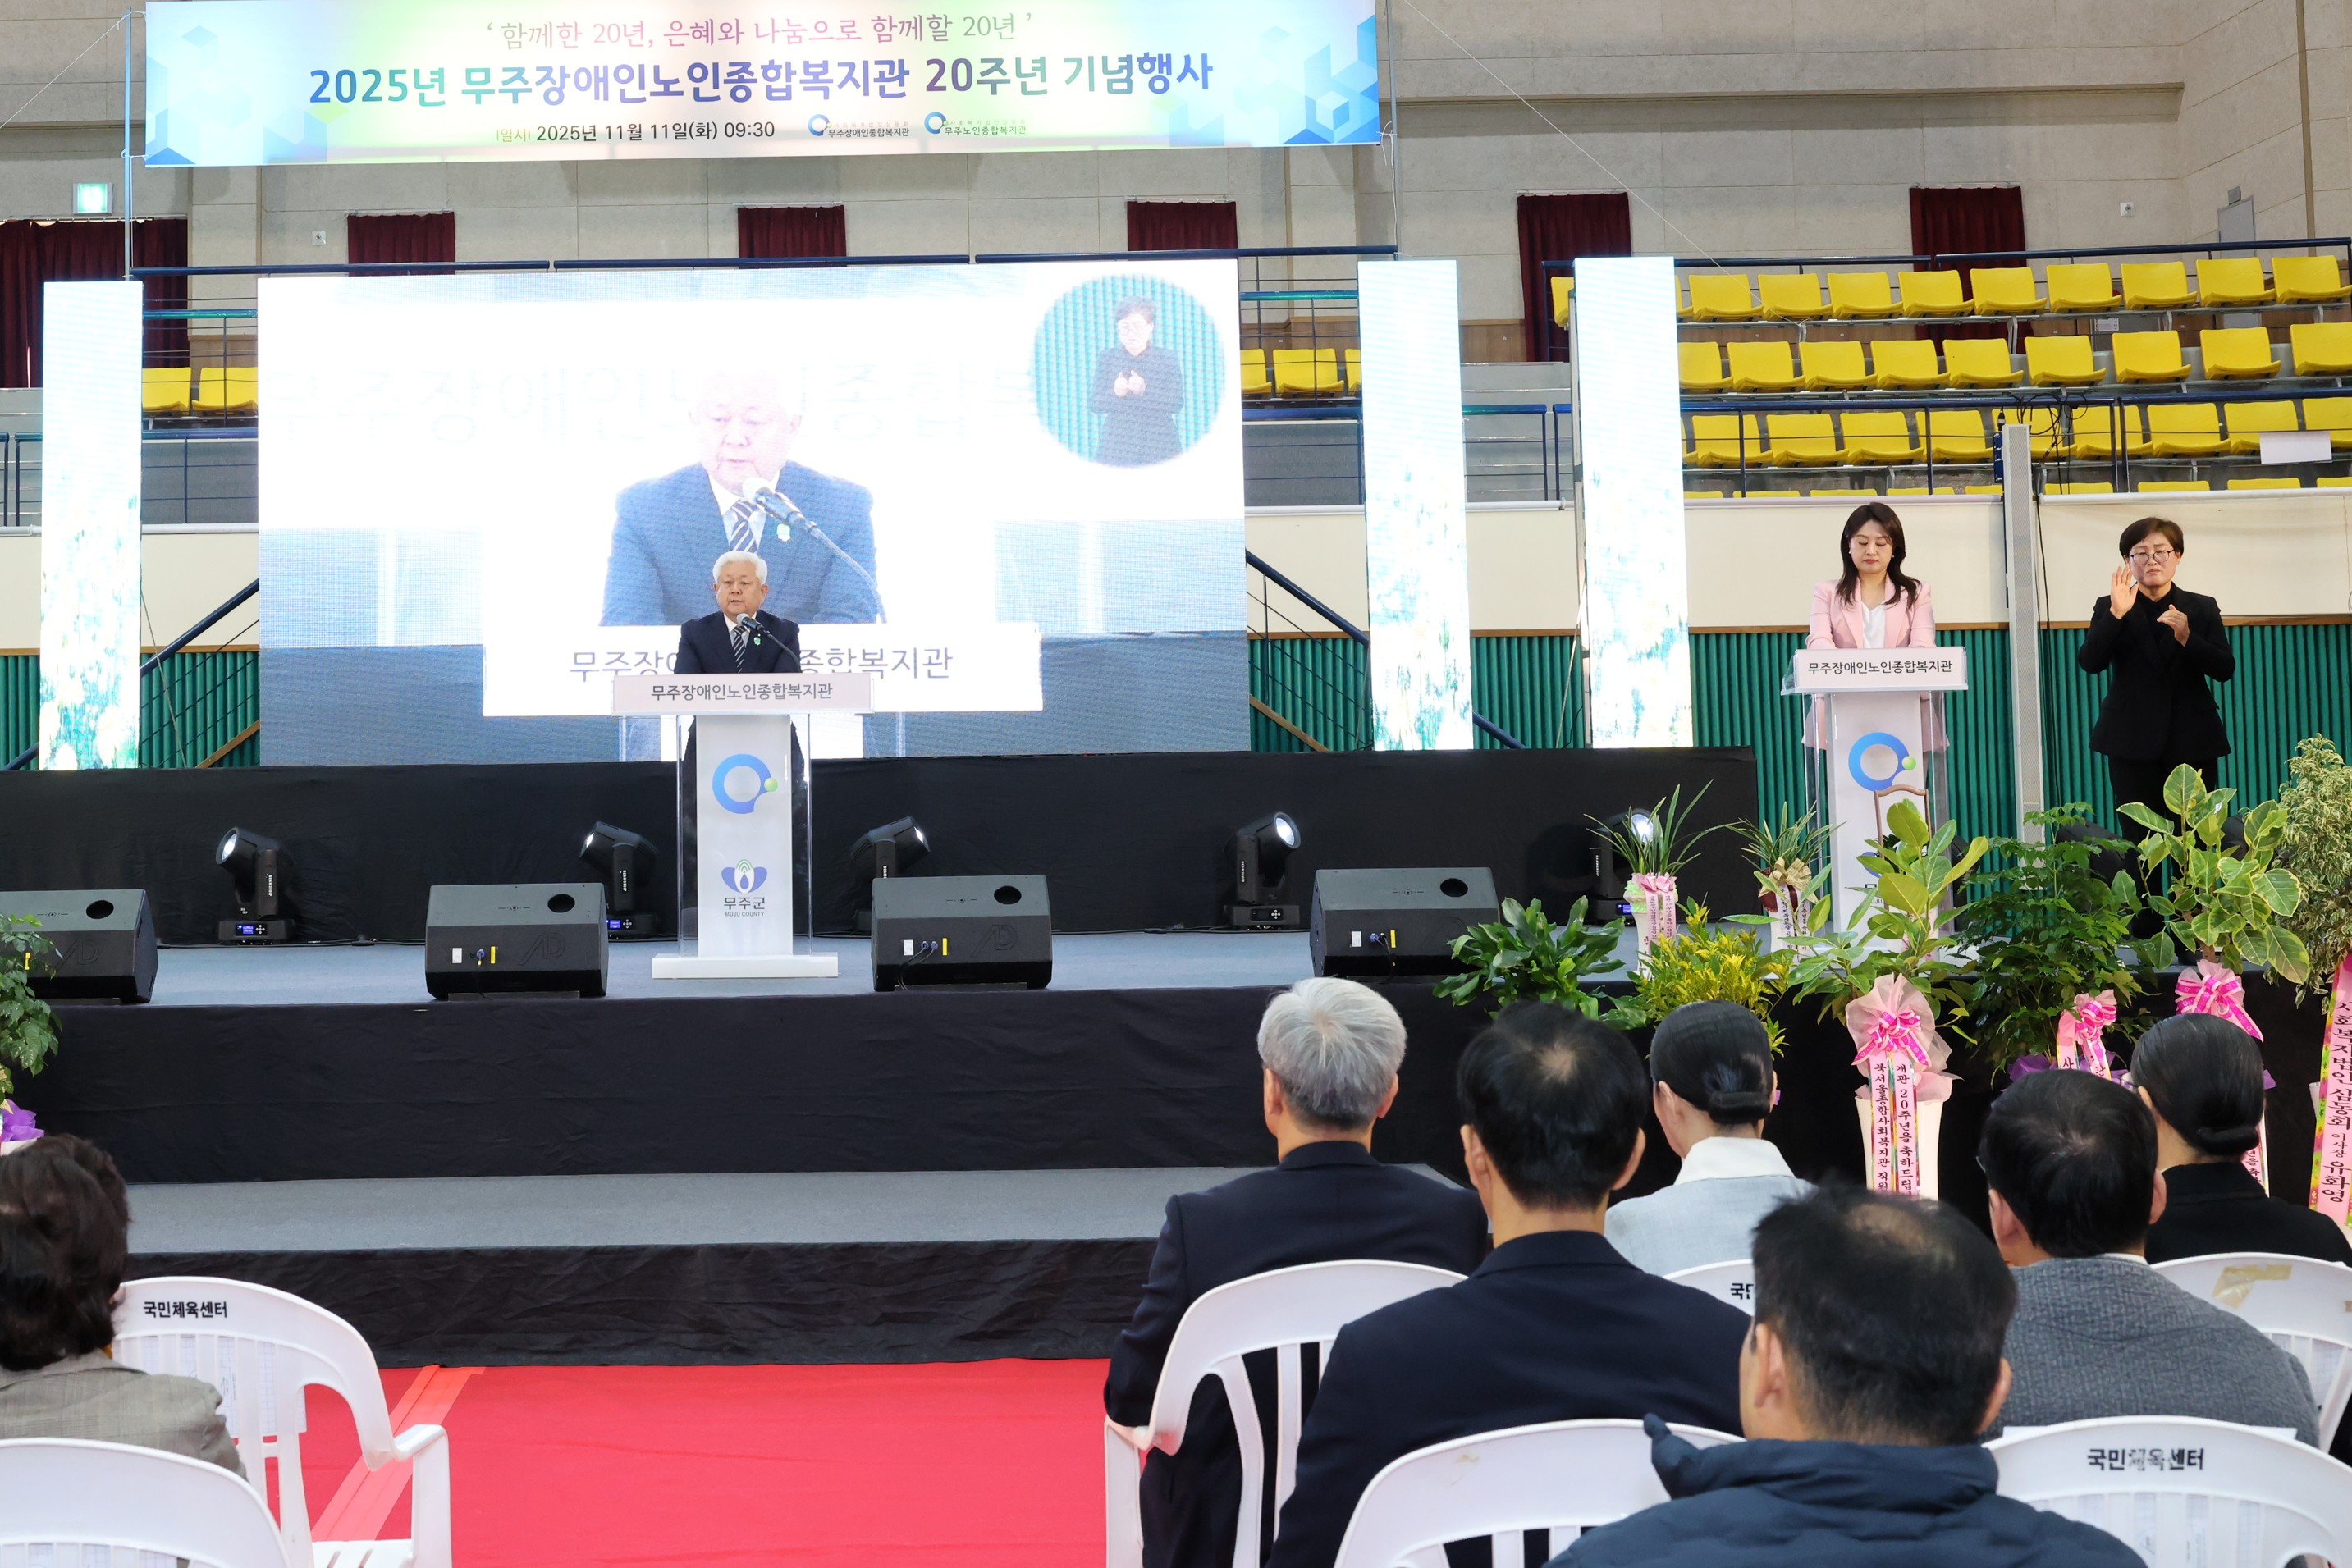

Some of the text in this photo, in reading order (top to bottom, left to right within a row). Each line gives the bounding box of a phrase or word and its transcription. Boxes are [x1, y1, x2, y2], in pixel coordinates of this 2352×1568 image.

[501, 21, 583, 50] 함께한
[593, 20, 653, 48] 20년,
[663, 18, 744, 48] 은혜와
[754, 17, 863, 46] 나눔으로
[871, 14, 953, 43] 함께할
[963, 12, 1014, 40] 20년
[309, 52, 1213, 107] 2025년 무주장애인노인종합복지관 20주년 기념행사
[536, 124, 597, 142] 2025년
[605, 123, 643, 140] 11월
[650, 121, 718, 140] 11일(화)
[724, 121, 776, 137] 09:30
[828, 128, 910, 138] 무주장애인종합복지관
[945, 126, 1027, 135] 무주노인종합복지관
[1807, 660, 1953, 674] 무주장애인노인종합복지관
[651, 683, 833, 701] 무주장애인노인종합복지관
[724, 897, 766, 910] 무주군
[1896, 1063, 1910, 1085] 개관
[1874, 1063, 1891, 1168] 북서울종합사회복지관
[1897, 1088, 1912, 1143] 20주년을
[2327, 1088, 2352, 1131] 삼동회
[2331, 1133, 2348, 1158] 이사장
[2321, 1161, 2352, 1203] 유화영
[143, 1301, 227, 1319] 국민체육센터
[2087, 1447, 2204, 1471] 국민체육센터
